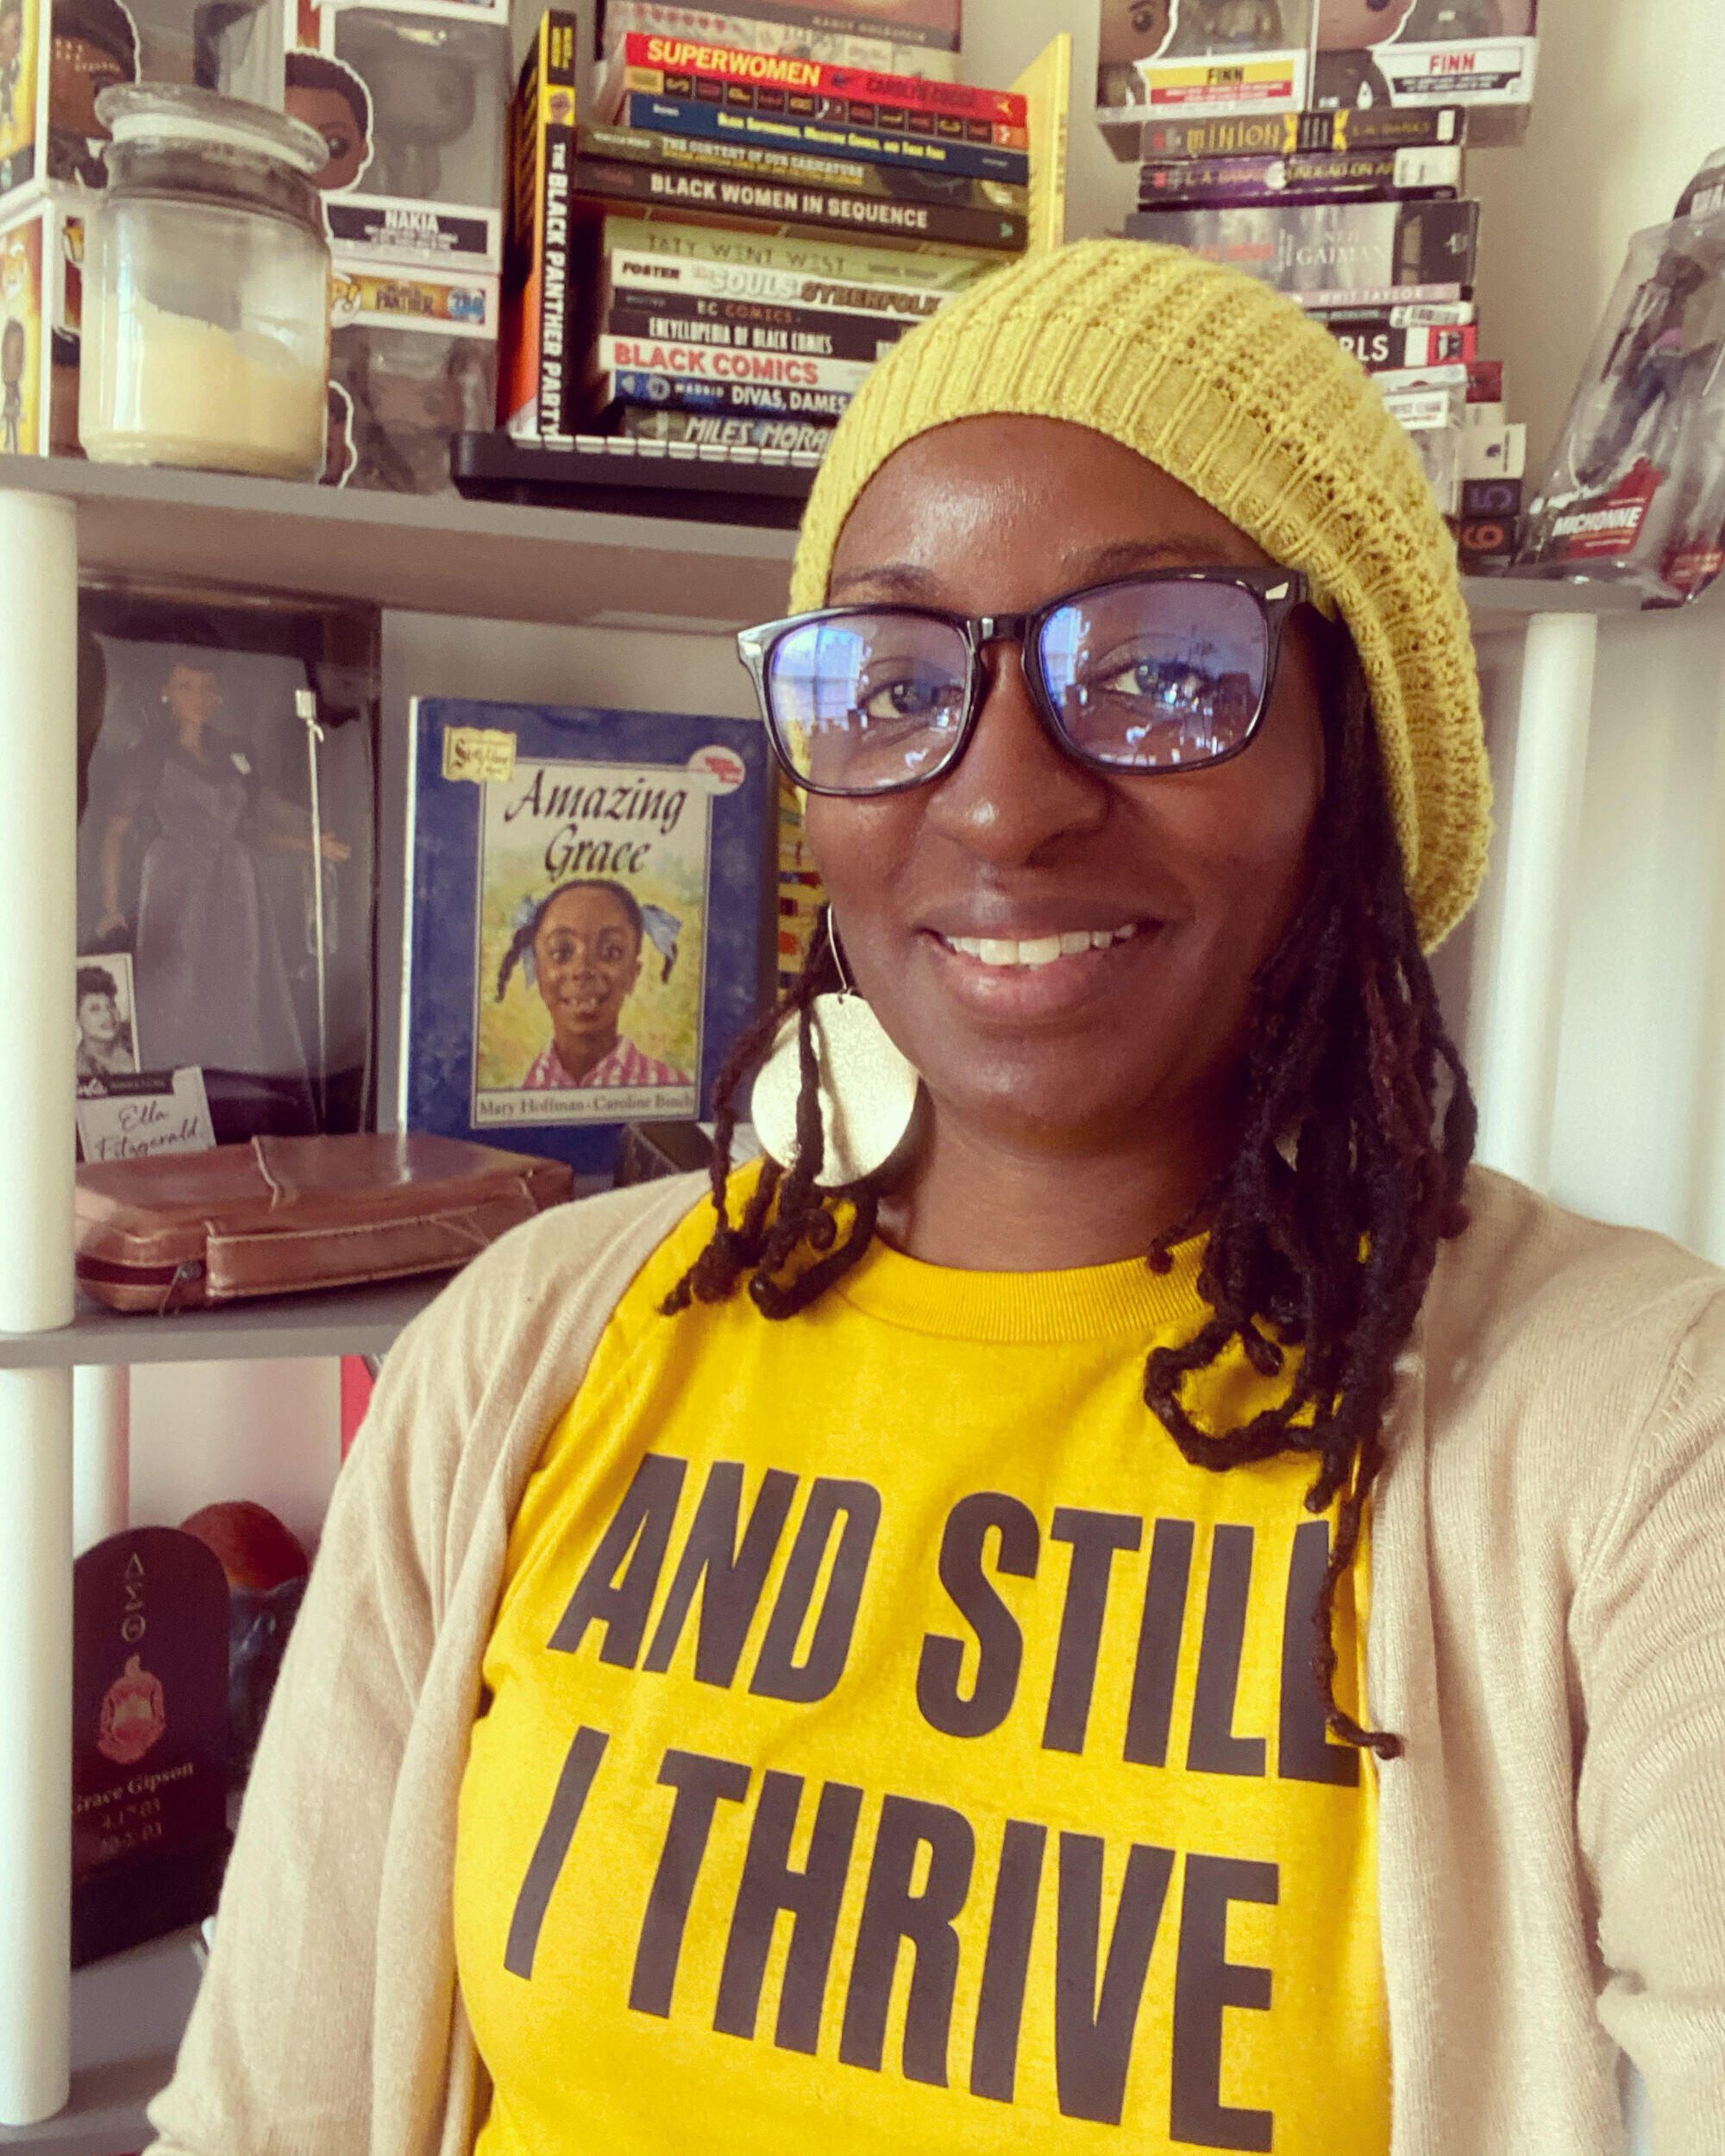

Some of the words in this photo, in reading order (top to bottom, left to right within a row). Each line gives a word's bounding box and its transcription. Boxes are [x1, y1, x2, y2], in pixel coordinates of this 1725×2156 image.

[647, 38, 821, 86] SUPERWOMEN
[1208, 66, 1244, 85] FINN
[1430, 53, 1476, 72] FINN
[1186, 122, 1281, 153] MINION
[546, 172, 568, 245] BLACK
[649, 173, 717, 201] BLACK
[720, 183, 798, 212] WOMEN
[802, 194, 825, 216] IN
[827, 198, 928, 229] SEQUENCE
[385, 209, 440, 233] NAKIA
[622, 261, 681, 280] FOSTER
[1295, 246, 1380, 266] GAIMAN
[542, 251, 566, 355] PANTHER
[696, 299, 718, 317] EC
[724, 302, 794, 324] COMICS
[614, 342, 706, 373] BLACK
[712, 352, 819, 385] COMICS
[1339, 335, 1390, 363] RLS
[539, 361, 562, 435] PARTY
[731, 385, 787, 411] DIVAS,
[789, 391, 848, 416] DAMES
[686, 417, 756, 446] MILES
[1552, 506, 1643, 537] MICHONNE
[505, 769, 688, 836] Amazing
[544, 823, 652, 883] Grace
[118, 1100, 168, 1132] Ella
[480, 1101, 514, 1117] Mary
[520, 1098, 584, 1114] Hoffman
[593, 1094, 649, 1111] Caroline
[94, 1116, 198, 1161] Fitzgerald
[547, 1452, 881, 1704] AND
[915, 1491, 1361, 1788] STILL
[128, 1762, 194, 1794] Gipson
[504, 1725, 610, 1982] I
[628, 1748, 1280, 2153] THRIVE
